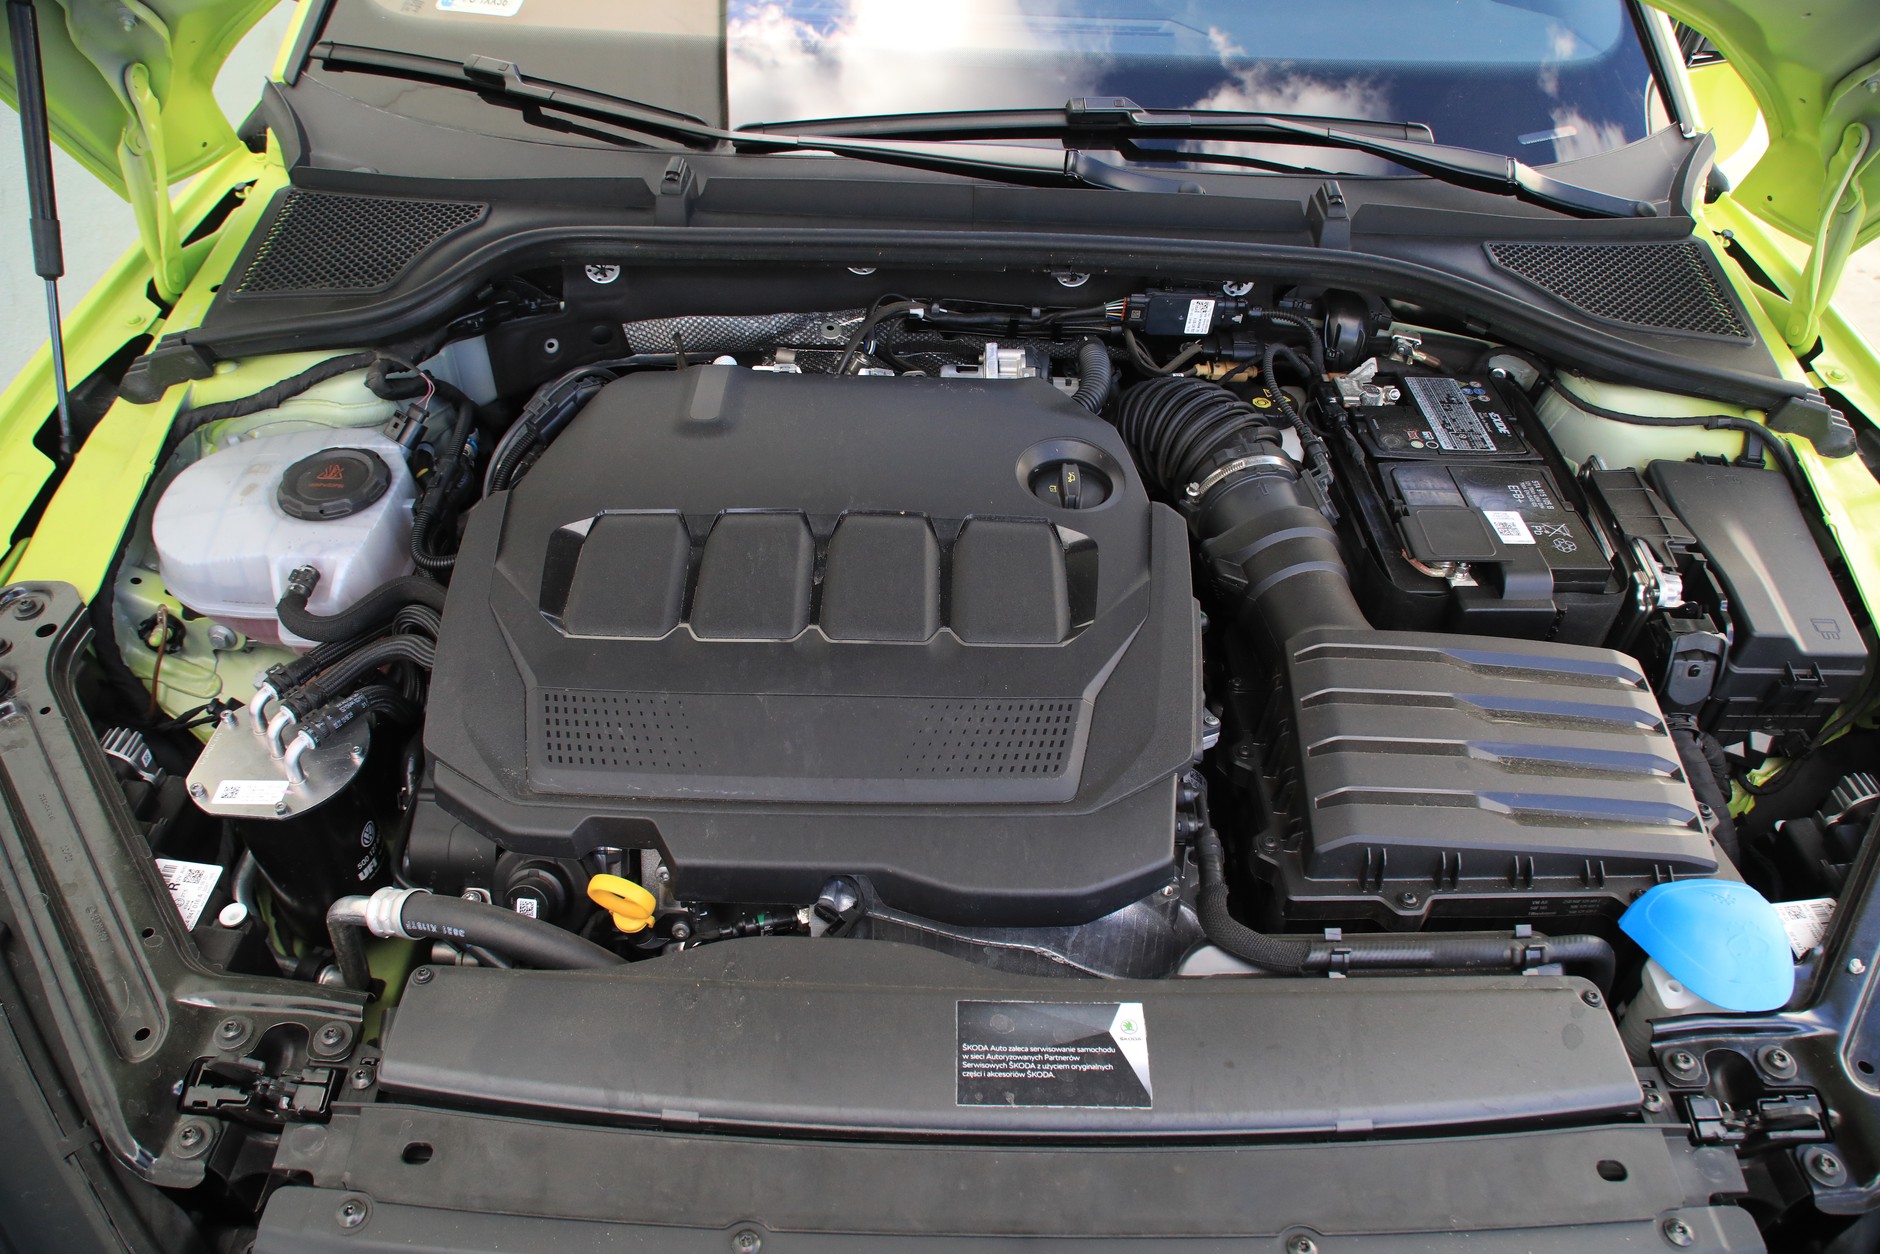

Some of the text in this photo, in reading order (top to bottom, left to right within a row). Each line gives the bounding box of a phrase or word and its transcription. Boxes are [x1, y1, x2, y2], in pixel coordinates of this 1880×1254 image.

[1507, 485, 1525, 504] EFB+
[1531, 525, 1544, 536] Pb
[962, 1043, 988, 1051] ŠKODA
[1029, 1045, 1076, 1053] serwisowanie
[1076, 1046, 1116, 1054] samochodu
[986, 1053, 1043, 1062] Autoryzowanych
[962, 1061, 1008, 1070] Serwisowych
[1008, 1061, 1036, 1069] ŠKODA
[1042, 1063, 1070, 1071] użyciem
[1071, 1063, 1114, 1071] oryginalnych
[962, 1070, 983, 1079] części
[986, 1070, 1026, 1078] akcesoriów
[1026, 1070, 1056, 1079] ŠKODA.
